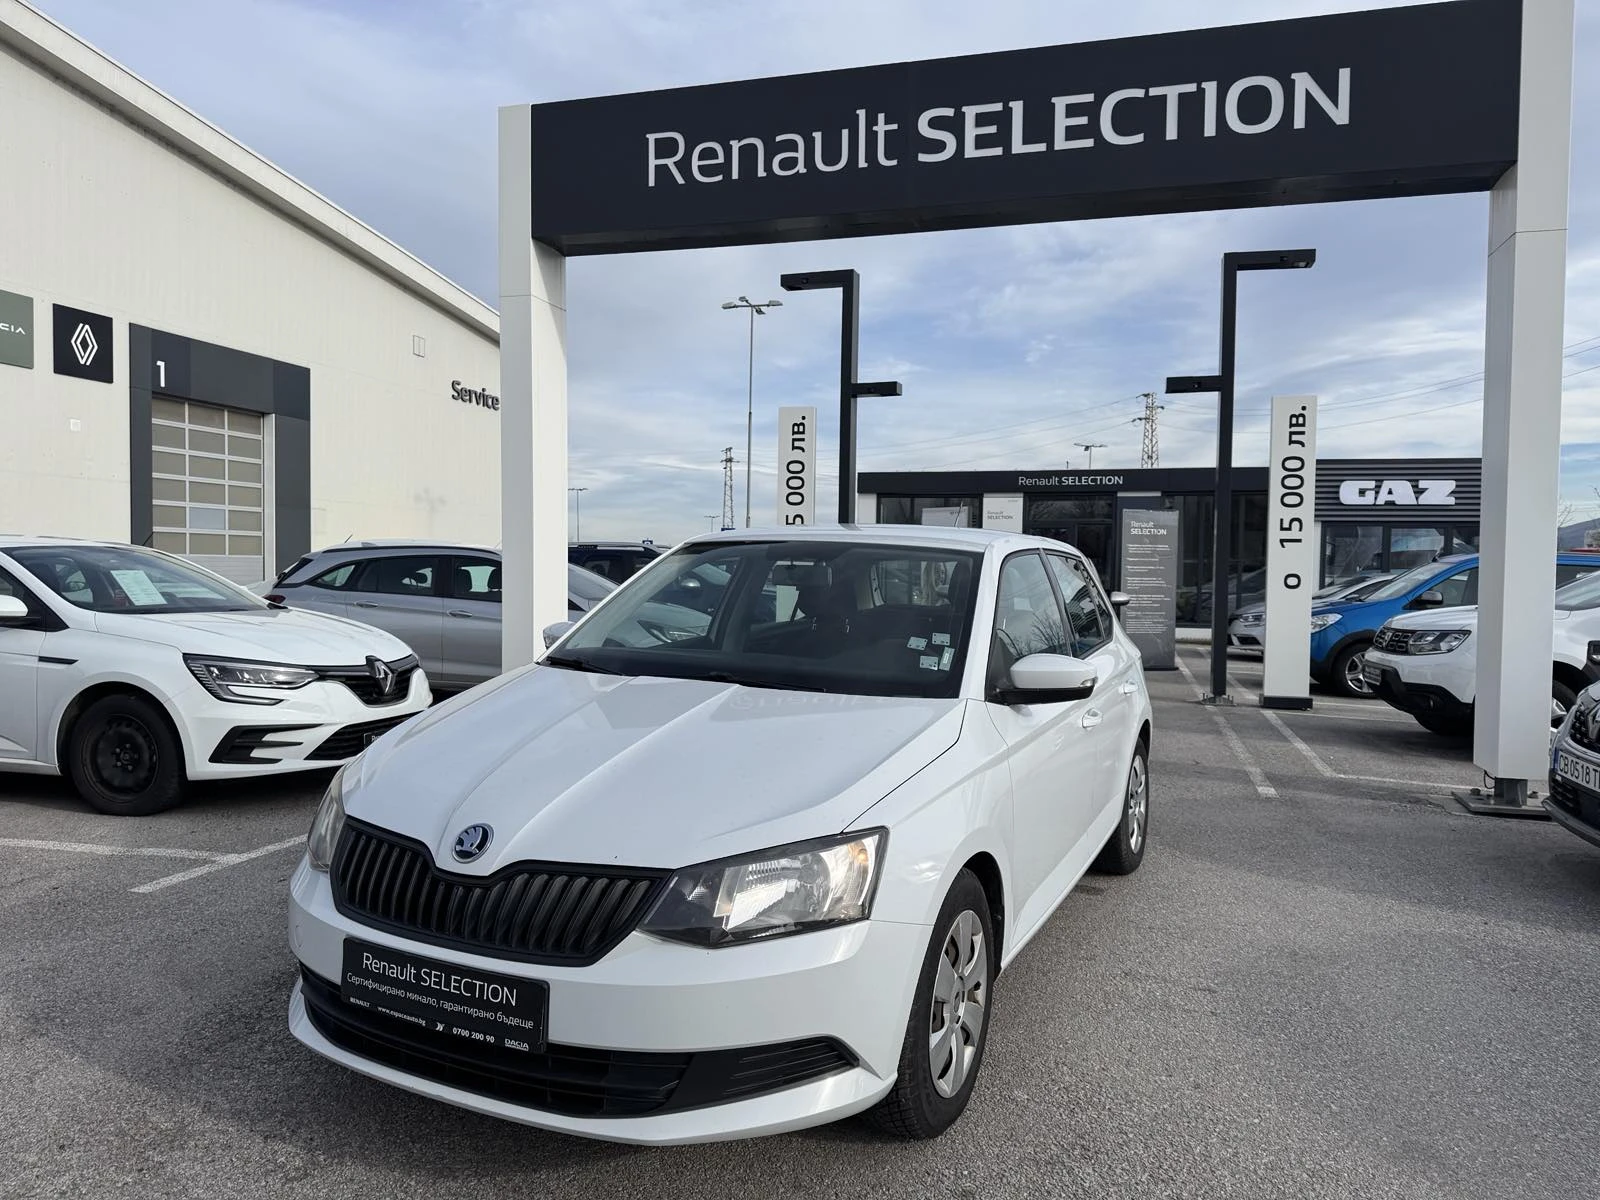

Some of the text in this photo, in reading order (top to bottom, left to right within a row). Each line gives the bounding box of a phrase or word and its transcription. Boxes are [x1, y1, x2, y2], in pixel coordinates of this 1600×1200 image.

[646, 67, 1351, 187] Renault SELECTION
[156, 360, 166, 388] 1
[451, 380, 500, 411] Service
[792, 416, 806, 452] лв.
[1288, 405, 1307, 448] лв.
[786, 460, 805, 506] 000
[1018, 475, 1124, 486] Renault SELECTION
[1280, 456, 1306, 508] 000
[1339, 480, 1456, 505] GAZ
[1279, 517, 1304, 549] 15
[1570, 760, 1590, 784] 0518
[1593, 768, 1600, 789] T
[362, 952, 517, 1007] Renault SELECTION
[347, 972, 534, 1029] Сертифицирано минало, гарантирано бъдеще
[452, 1027, 470, 1037] 0700
[471, 1031, 485, 1041] 200
[486, 1034, 495, 1044] 90
[504, 1038, 529, 1049] DACIA
